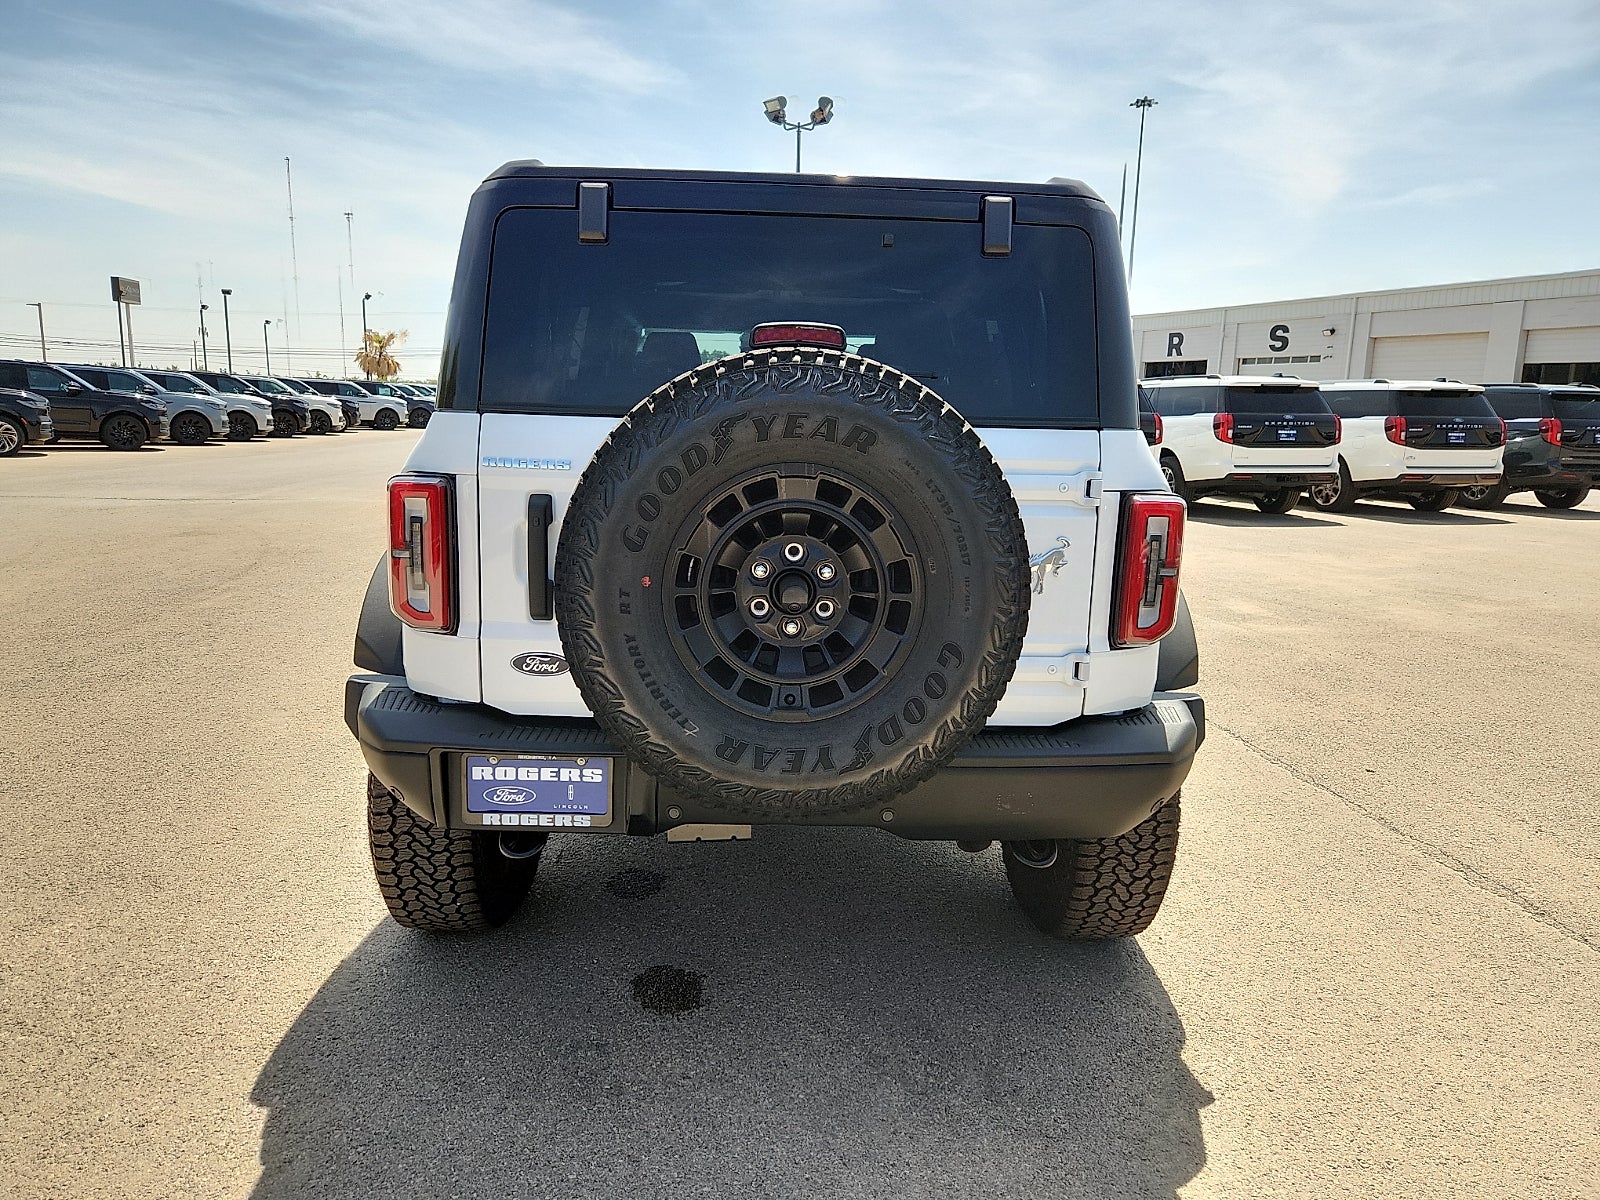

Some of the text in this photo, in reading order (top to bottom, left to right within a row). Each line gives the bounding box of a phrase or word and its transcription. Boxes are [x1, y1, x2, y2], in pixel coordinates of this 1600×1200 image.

[1167, 332, 1184, 357] R
[1268, 324, 1290, 352] S
[482, 456, 572, 470] ROGERS
[522, 655, 560, 672] Ford
[471, 766, 603, 783] ROGERS
[493, 788, 527, 802] Ford
[482, 813, 592, 827] ROGERS
